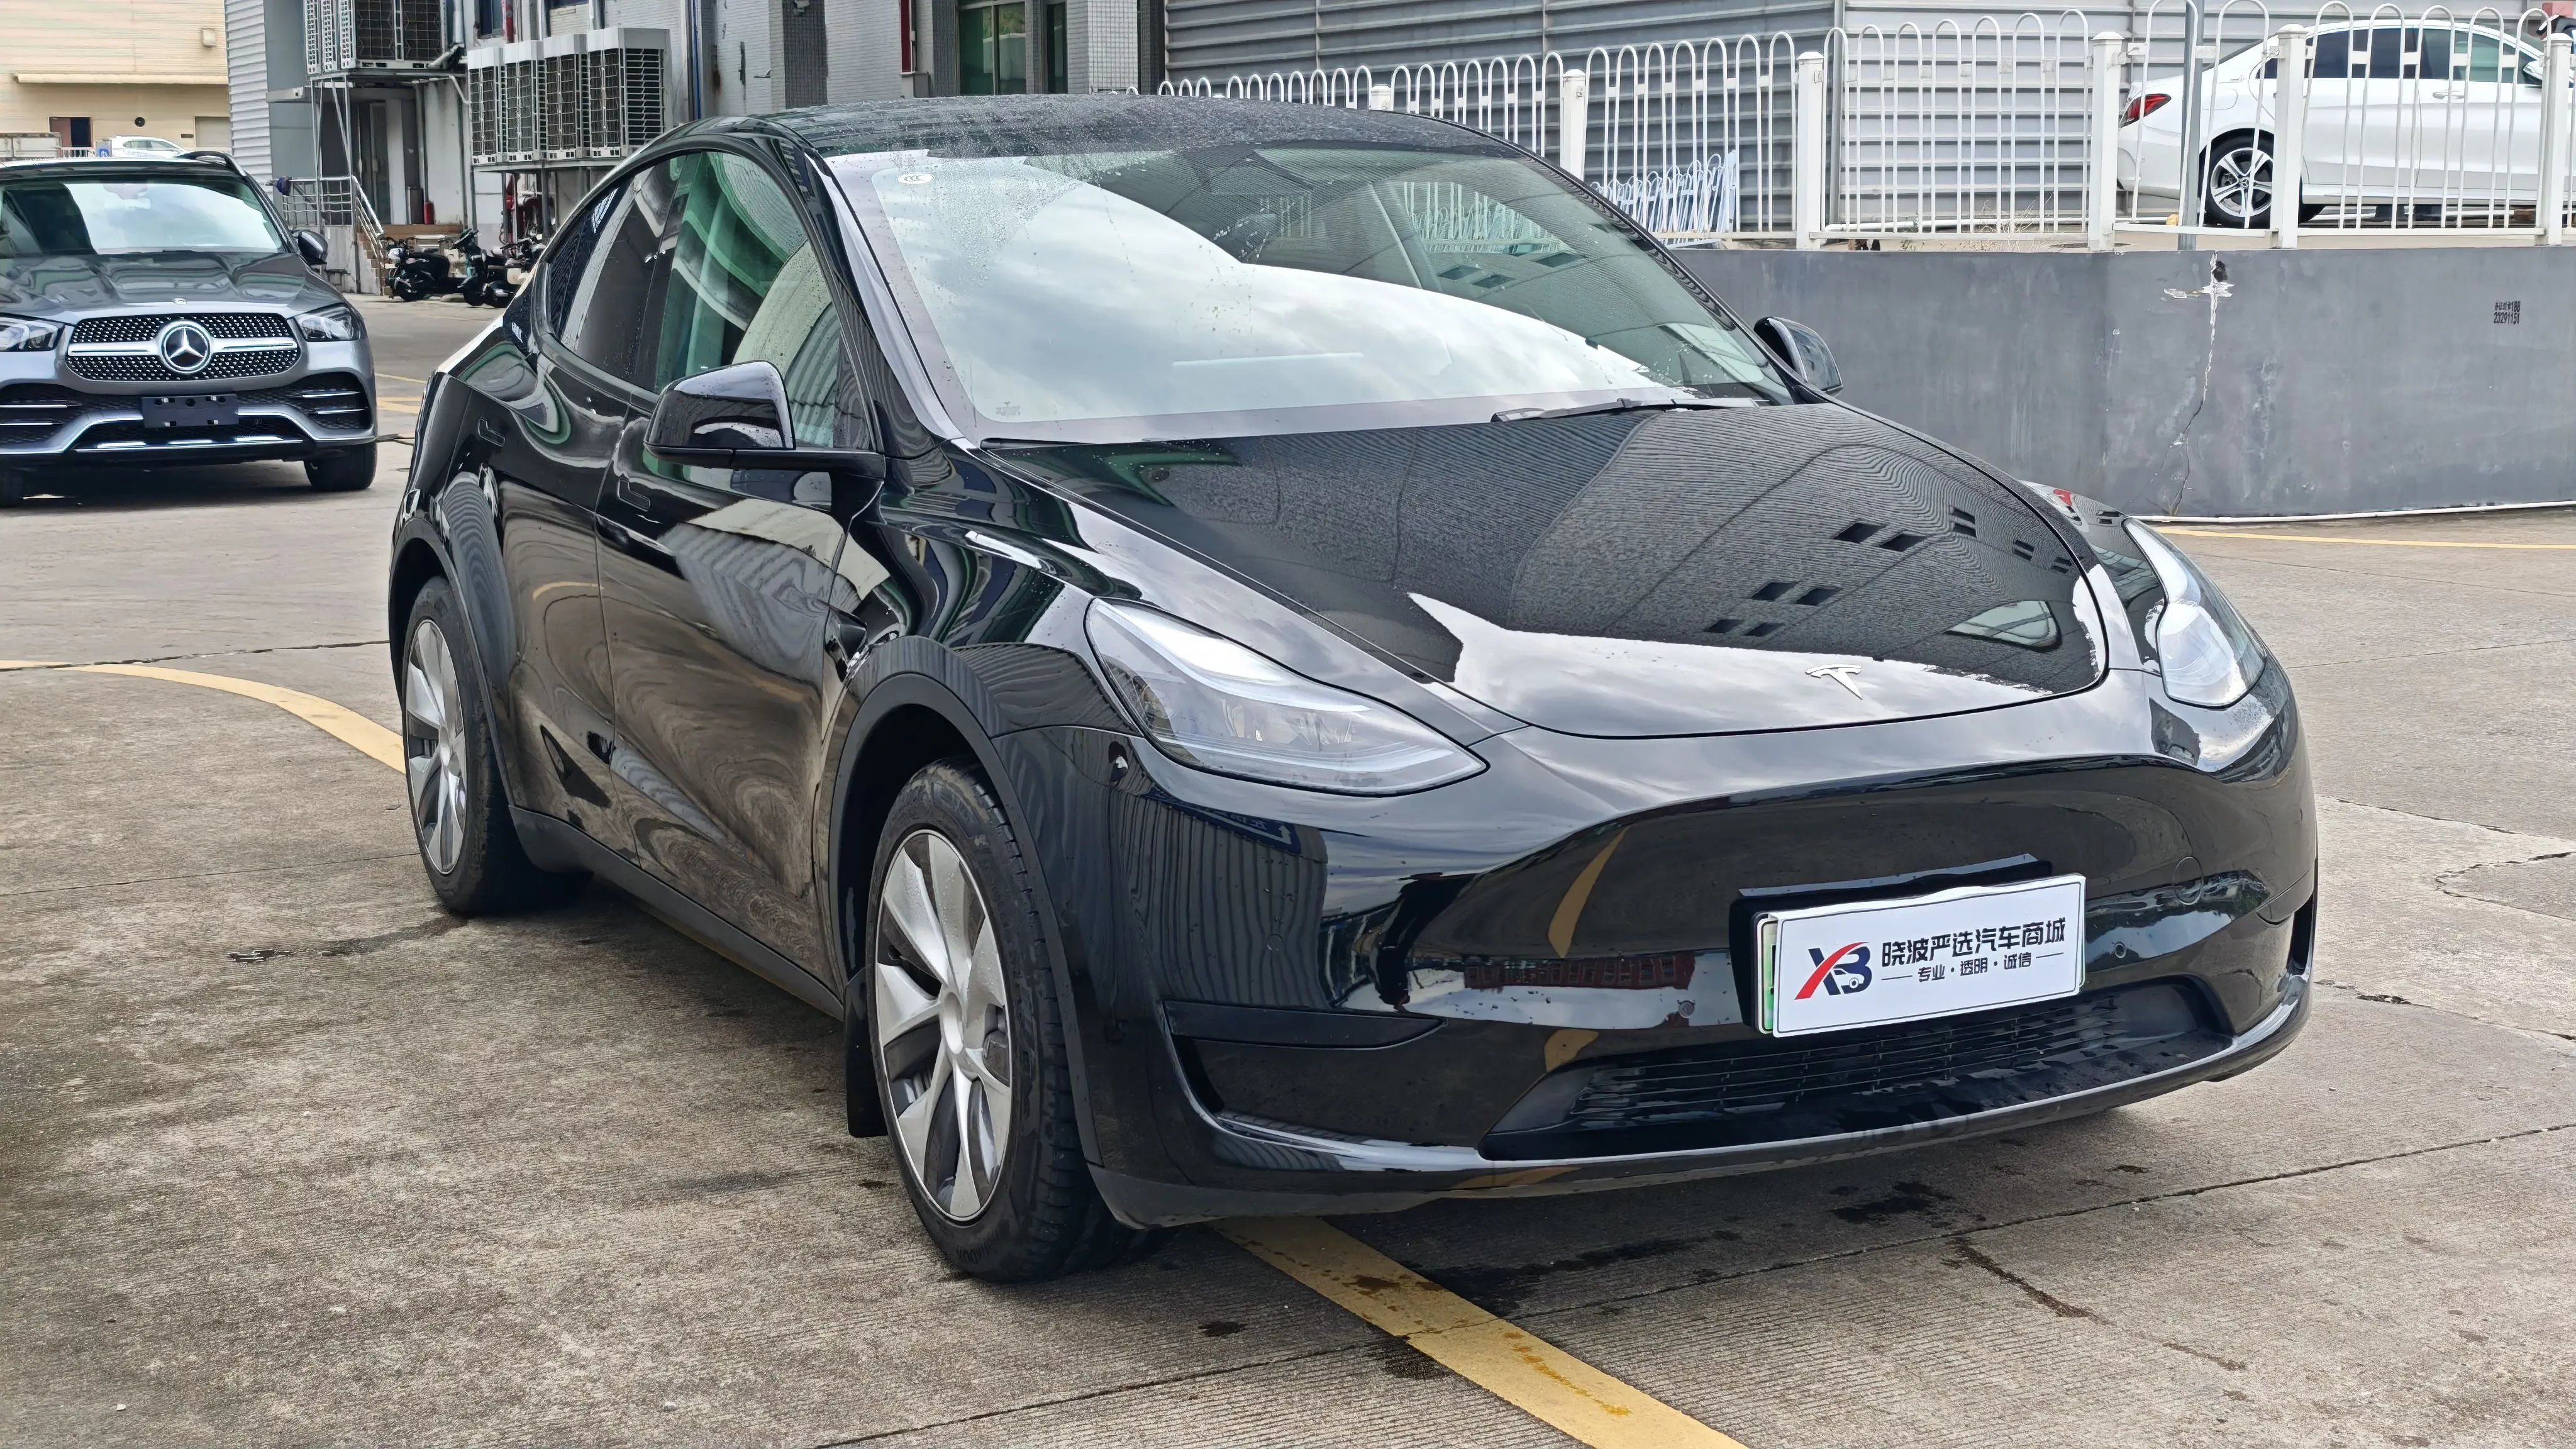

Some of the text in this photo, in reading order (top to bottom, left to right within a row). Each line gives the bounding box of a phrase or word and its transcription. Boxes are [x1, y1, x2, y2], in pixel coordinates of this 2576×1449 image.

[1881, 917, 2066, 967] 晓波严选汽车商城
